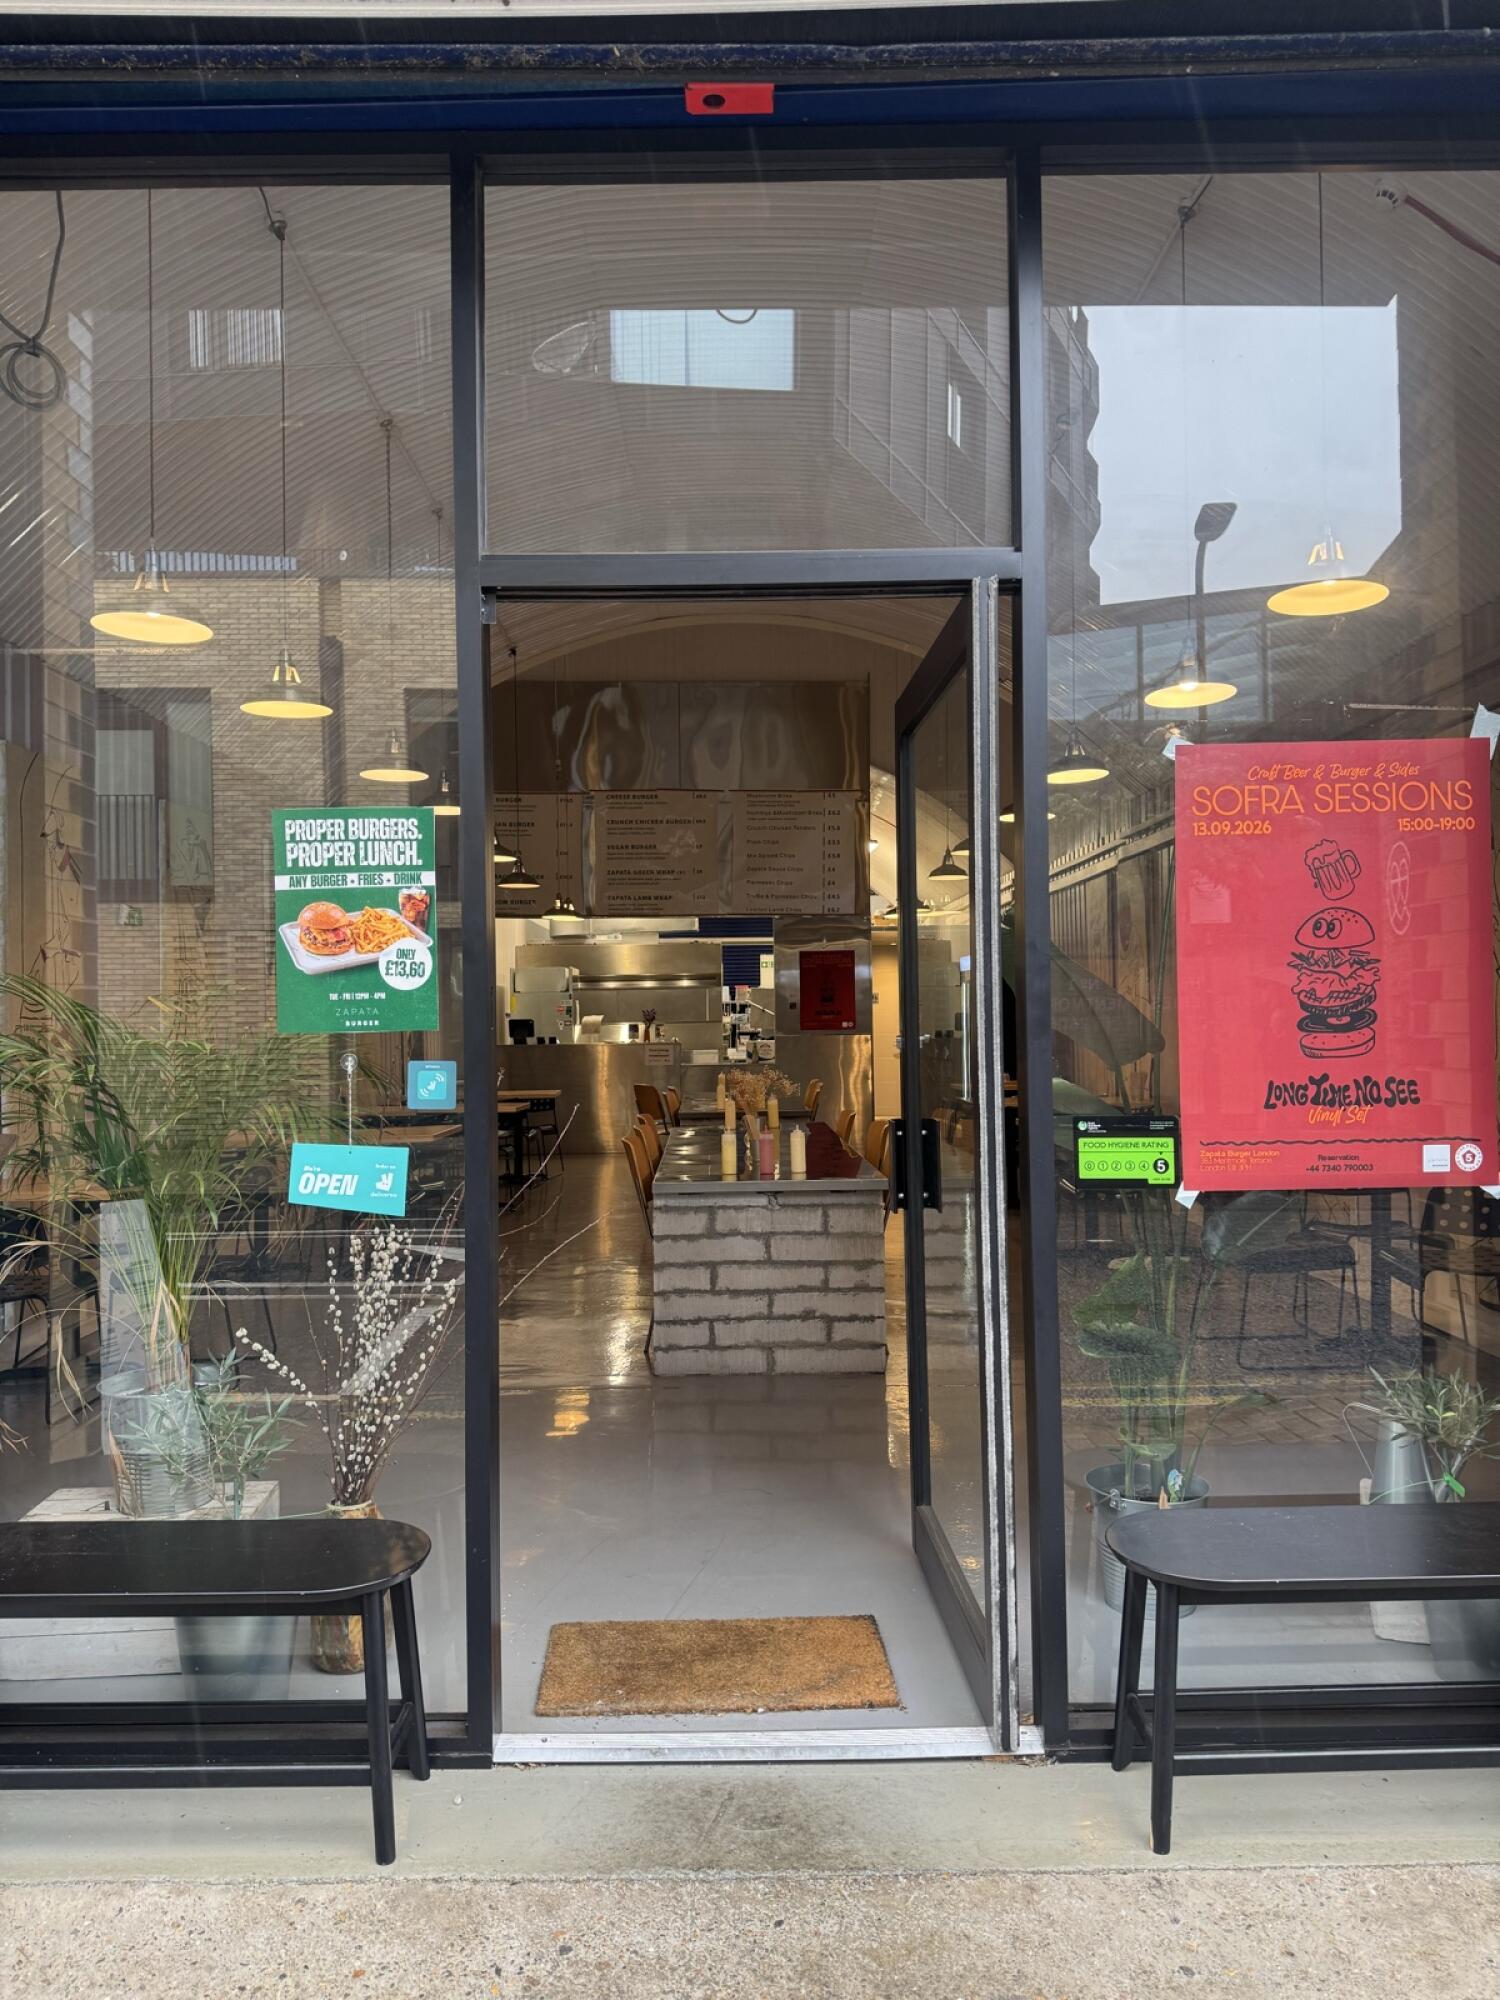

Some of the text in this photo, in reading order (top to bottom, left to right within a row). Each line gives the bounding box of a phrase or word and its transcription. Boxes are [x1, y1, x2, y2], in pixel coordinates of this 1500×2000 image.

[1247, 762, 1419, 781] Craft Beer & Burger & Sides
[1191, 780, 1473, 816] SOFRA SESSIONS
[285, 817, 423, 841] PROPER BURGERS.
[1192, 820, 1272, 837] 13.09.2026
[1397, 816, 1475, 832] 15:00-19:00
[286, 840, 423, 868] PROPER LUNCH.
[289, 875, 307, 889] ANY
[311, 874, 348, 888] BURGER
[358, 873, 384, 886] FRIES
[394, 872, 422, 885] DRINK
[396, 948, 416, 959] ONLY
[385, 961, 425, 978] £13,60
[335, 1007, 379, 1016] ZAPATA
[1263, 1073, 1421, 1111] LONG TIME NO SEE
[1308, 1104, 1374, 1127] Vinyl Set
[1200, 1150, 1226, 1159] Zapata
[1227, 1150, 1251, 1158] Burger
[1317, 1153, 1360, 1161] Reservation
[1157, 1160, 1165, 1172] 5
[1322, 1164, 1341, 1172] 7340
[298, 1172, 359, 1196] OPEN
